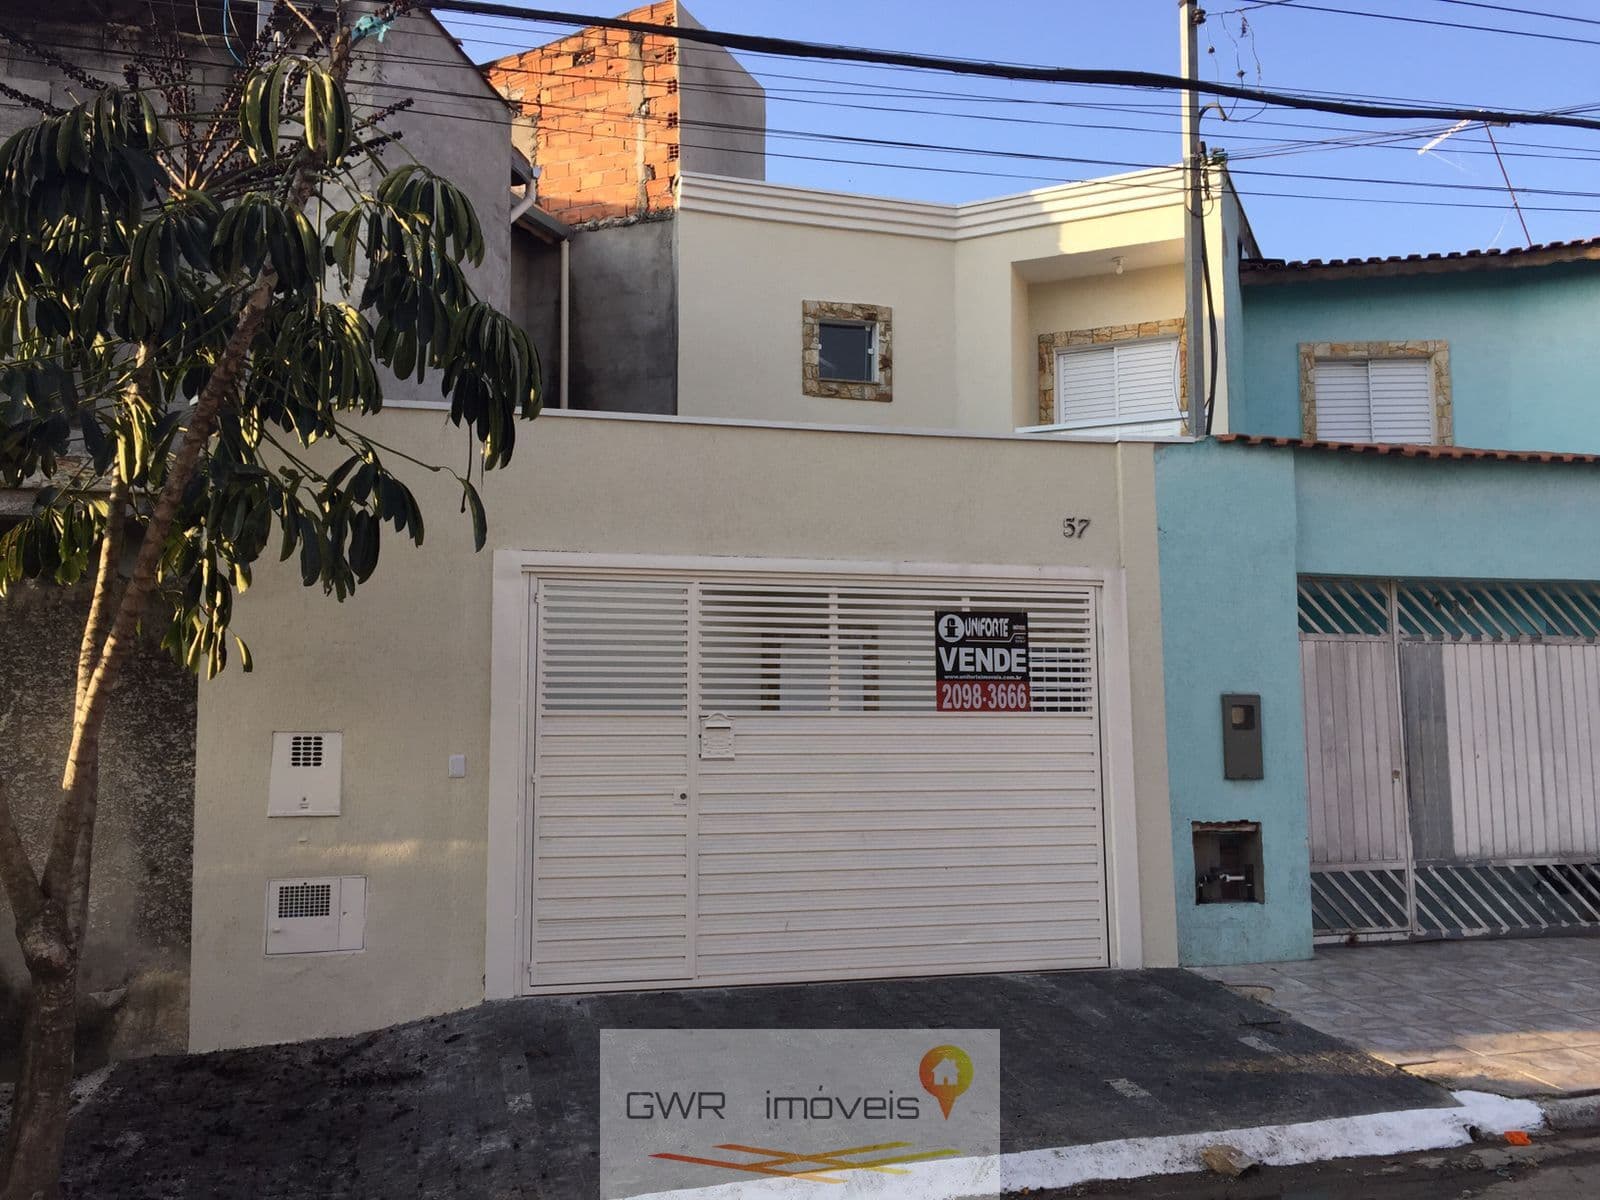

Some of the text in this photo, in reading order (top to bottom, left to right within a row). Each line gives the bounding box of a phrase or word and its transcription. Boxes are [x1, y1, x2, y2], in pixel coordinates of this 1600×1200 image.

[1063, 517, 1091, 539] 57
[965, 617, 1009, 637] UNIFORTE
[938, 646, 1027, 673] VENDE
